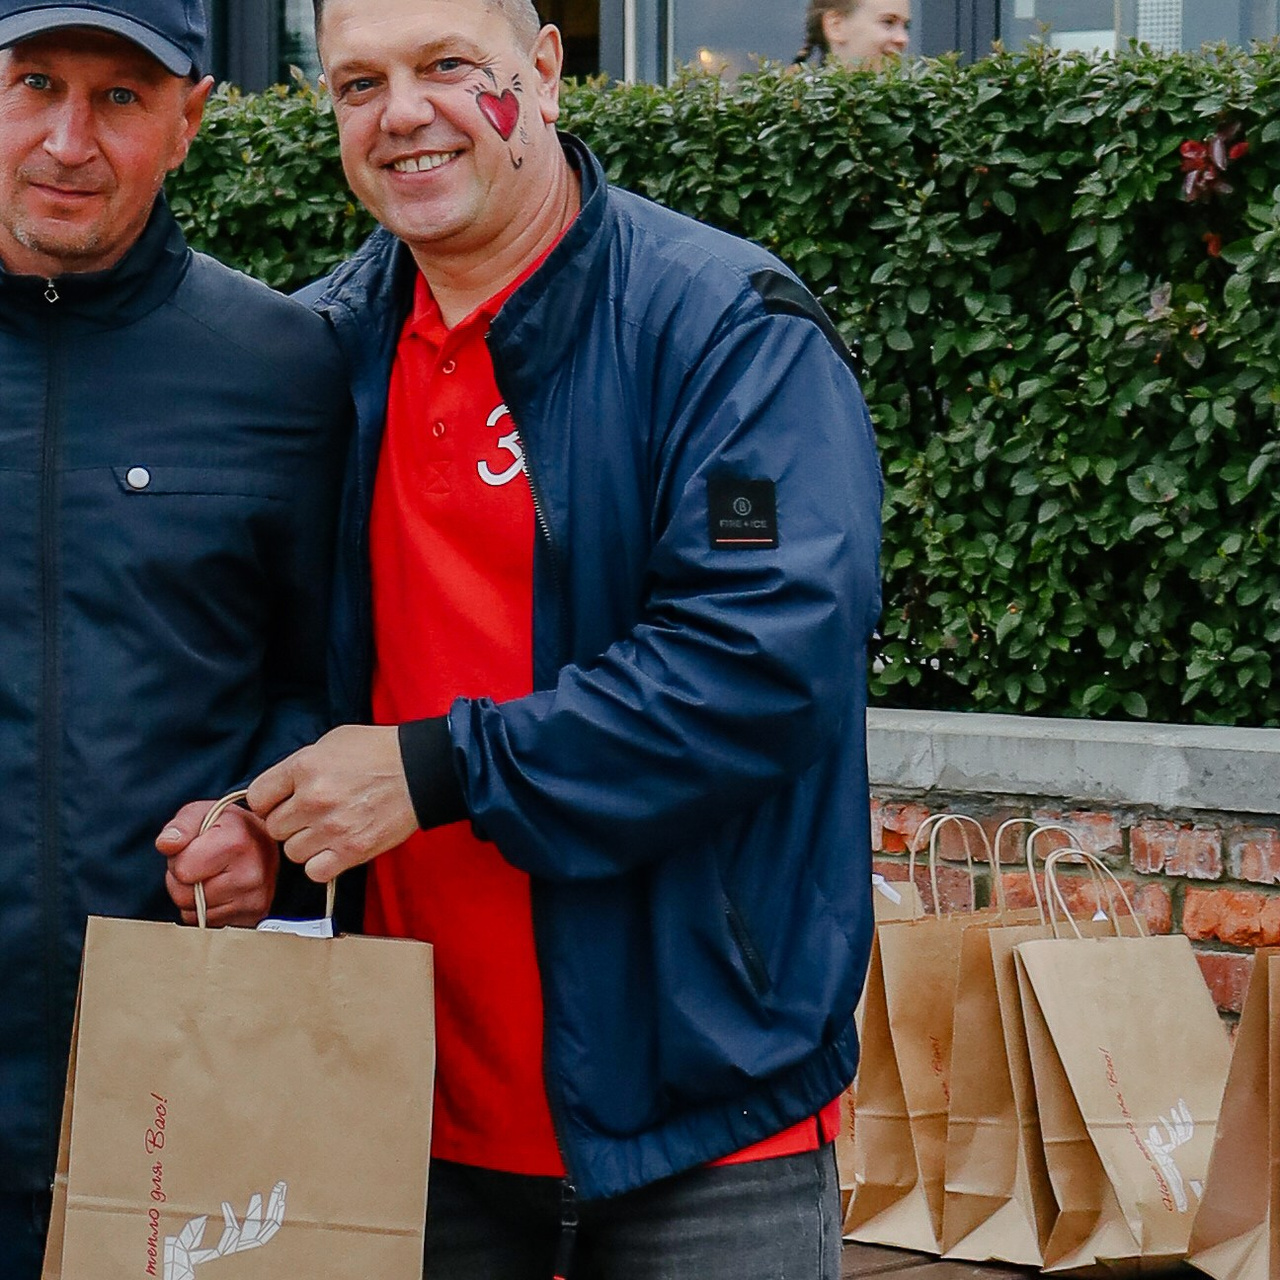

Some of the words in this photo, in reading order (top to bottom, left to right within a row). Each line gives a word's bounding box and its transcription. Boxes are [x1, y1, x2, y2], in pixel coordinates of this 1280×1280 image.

[477, 403, 525, 486] 3
[145, 1092, 167, 1154] Вас!
[150, 1161, 166, 1202] для
[145, 1208, 160, 1276] тепло
